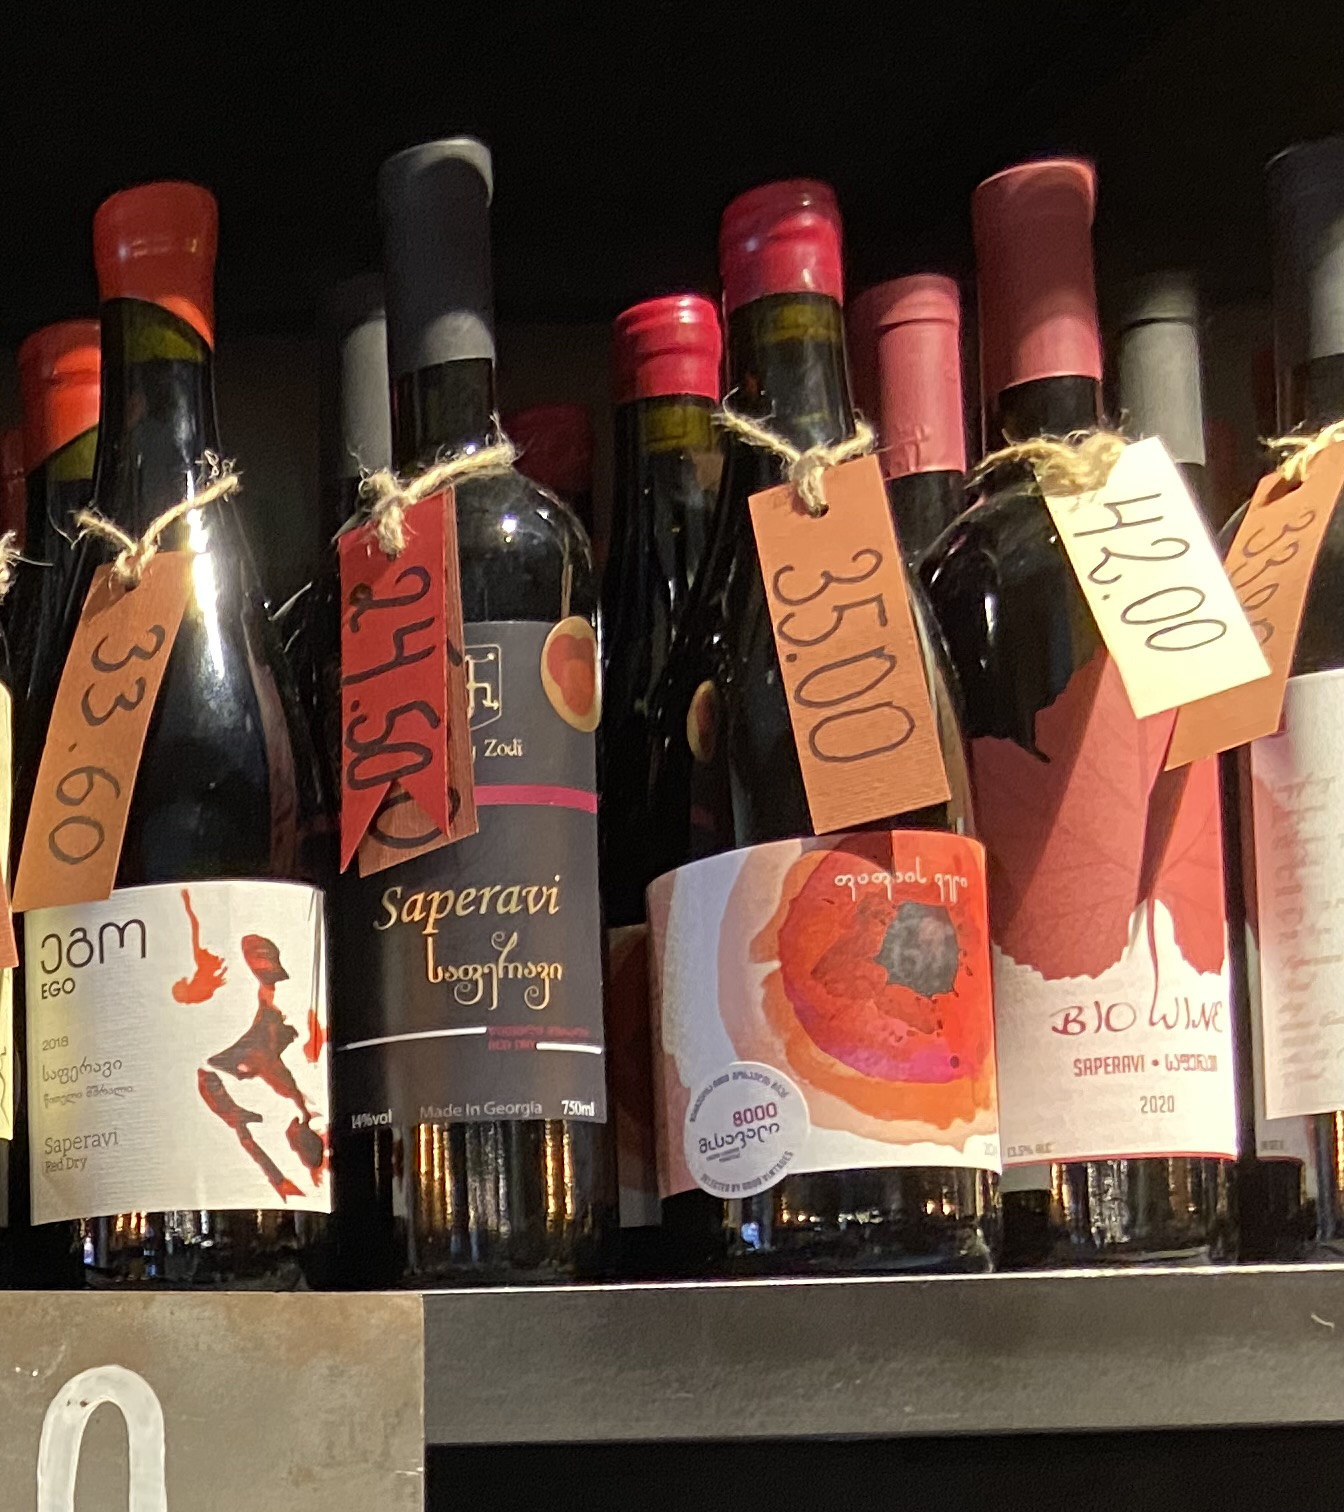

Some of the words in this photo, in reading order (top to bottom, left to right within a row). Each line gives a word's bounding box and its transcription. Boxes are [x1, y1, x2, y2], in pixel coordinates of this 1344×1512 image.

[1073, 493, 1228, 652] 42.00
[772, 548, 916, 763] 35.00
[48, 624, 166, 865] 33.60
[373, 873, 561, 935] Saperavi
[40, 918, 147, 975] ეგო
[425, 931, 563, 1012] საფერავი
[41, 977, 76, 1000] EGO
[42, 1056, 124, 1085] საფერავი
[1073, 1054, 1146, 1078] SAPERAVI
[419, 1102, 462, 1120] Made
[465, 1102, 481, 1118] In
[483, 1100, 543, 1119] Georgia
[561, 1099, 596, 1117] 750ml
[732, 1101, 778, 1128] 8000
[1139, 1095, 1175, 1115] 2020
[44, 1127, 120, 1158] Saperavi
[66, 1156, 88, 1173] Dry
